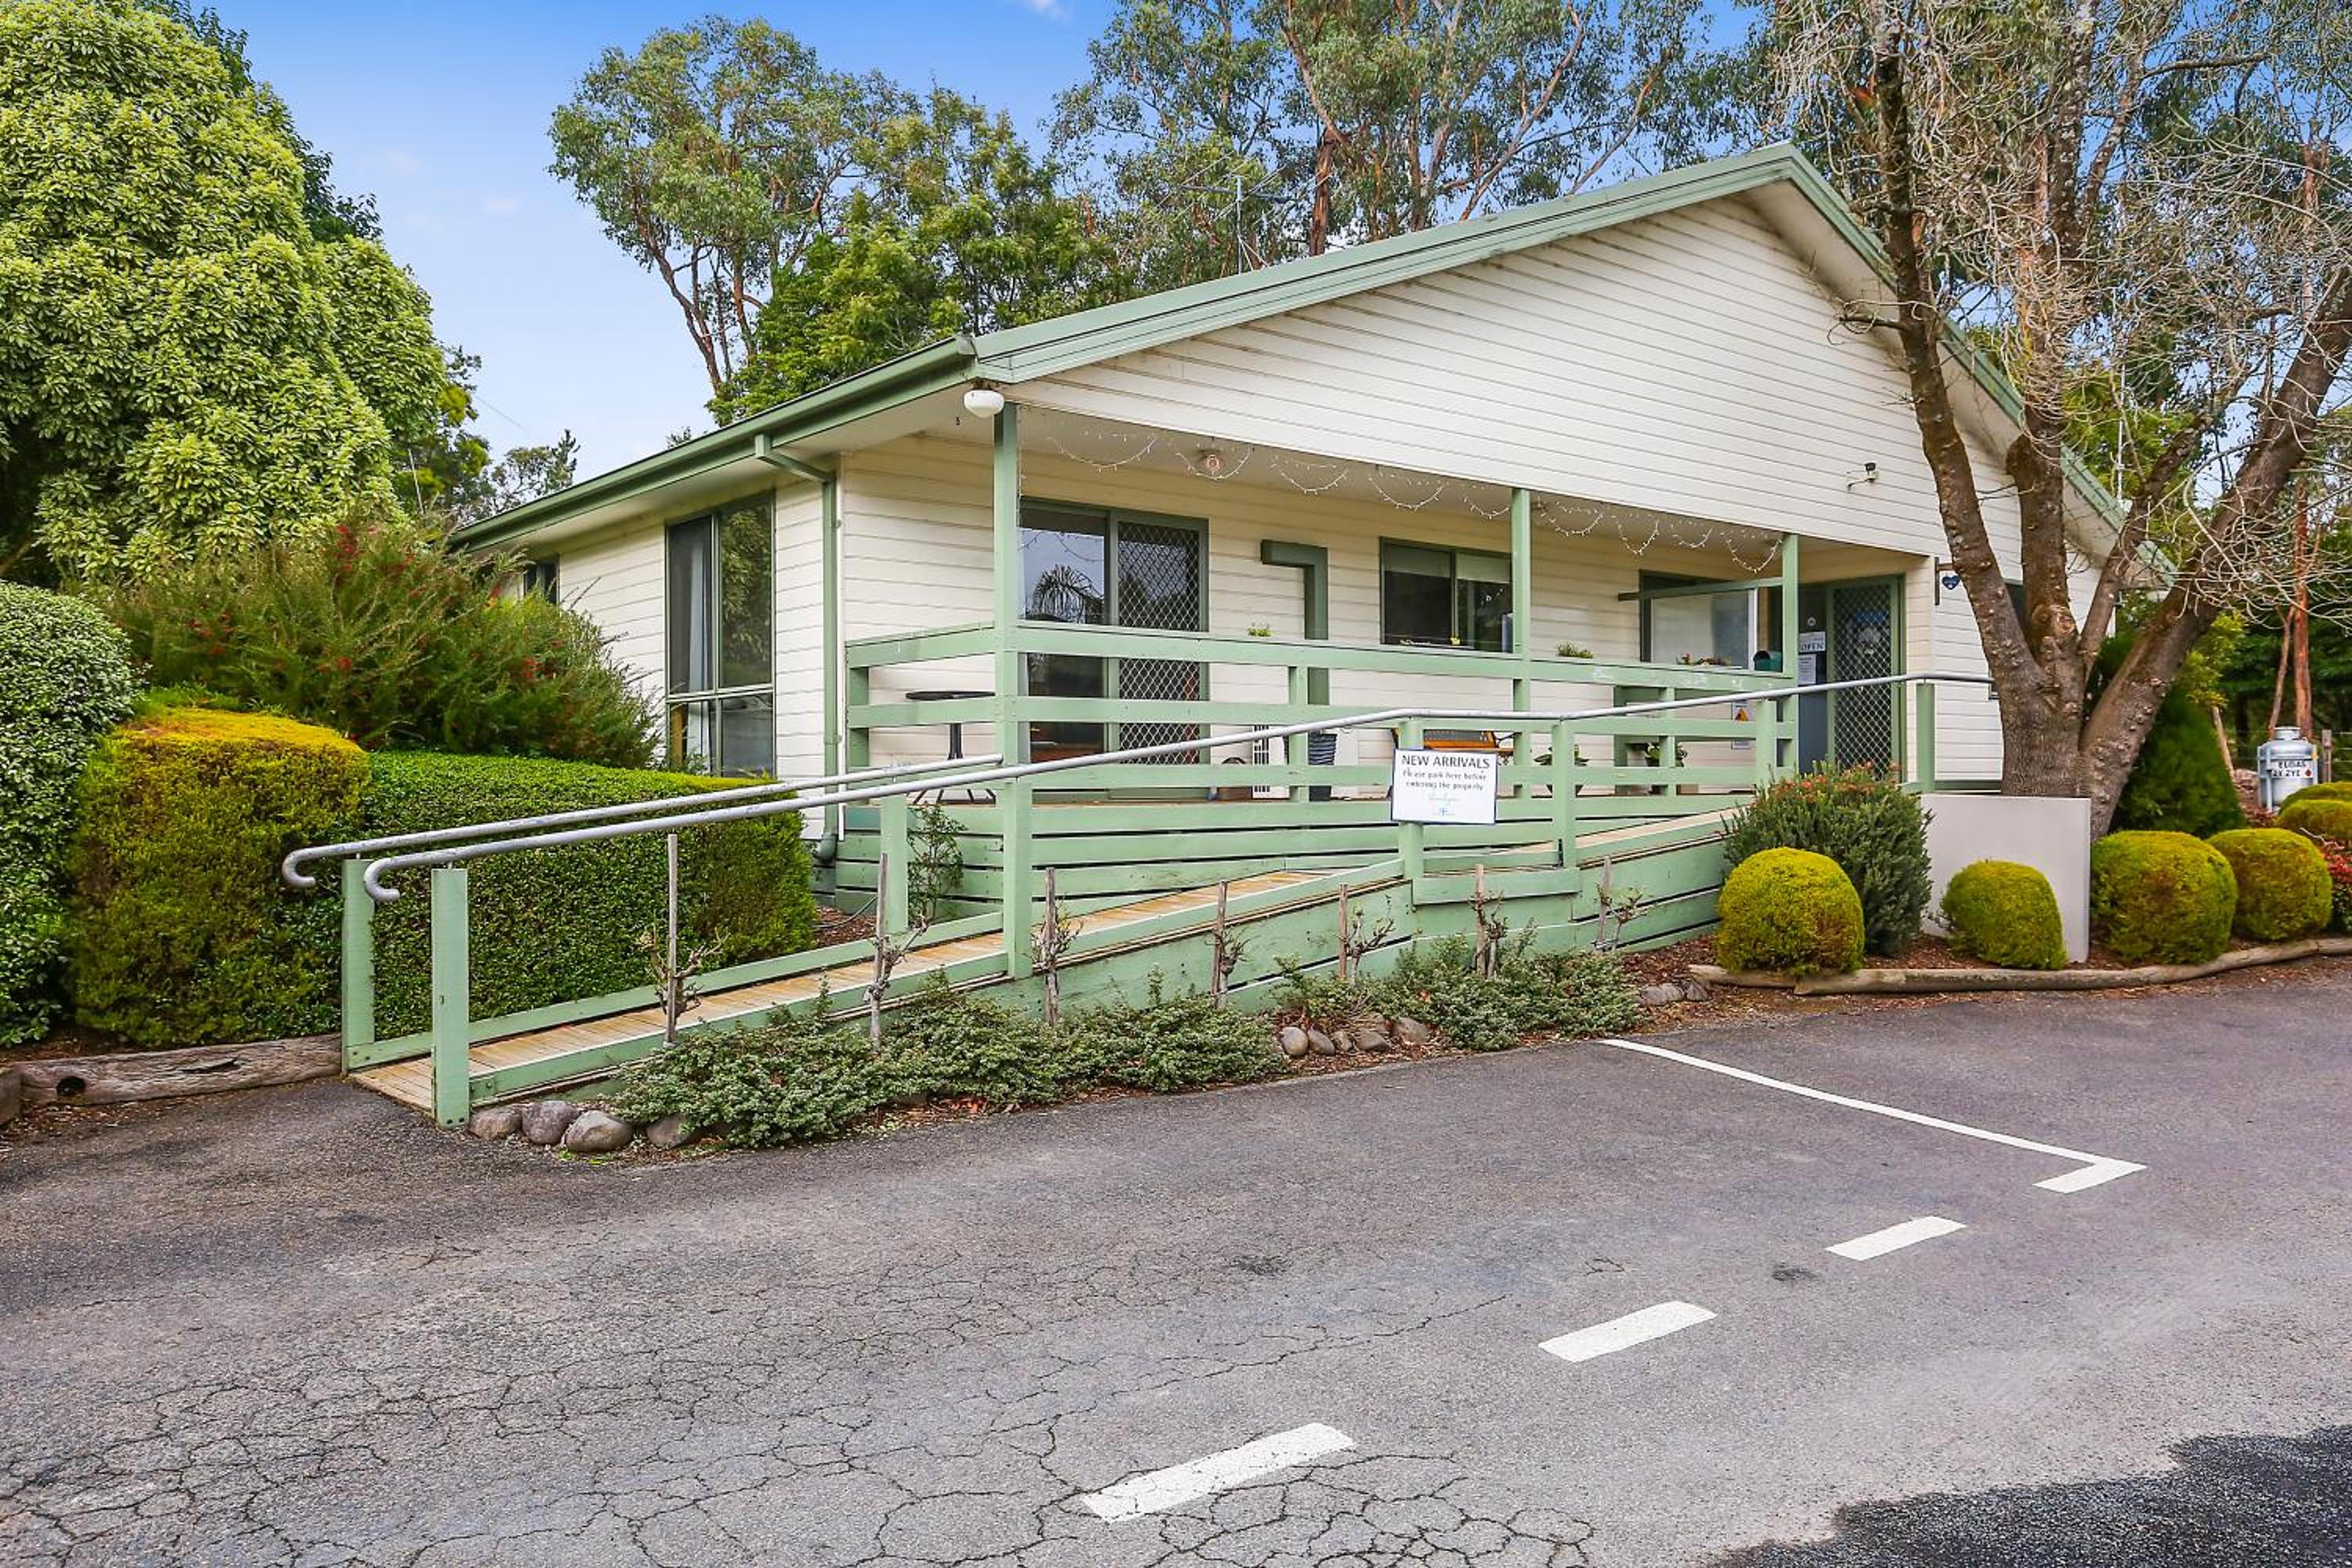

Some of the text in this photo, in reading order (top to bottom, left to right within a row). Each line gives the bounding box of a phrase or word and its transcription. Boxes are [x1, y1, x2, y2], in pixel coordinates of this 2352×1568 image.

[1801, 643, 1824, 652] OPEN
[1402, 755, 1490, 768] NEW ARRIVALS
[1403, 768, 1425, 777] Please
